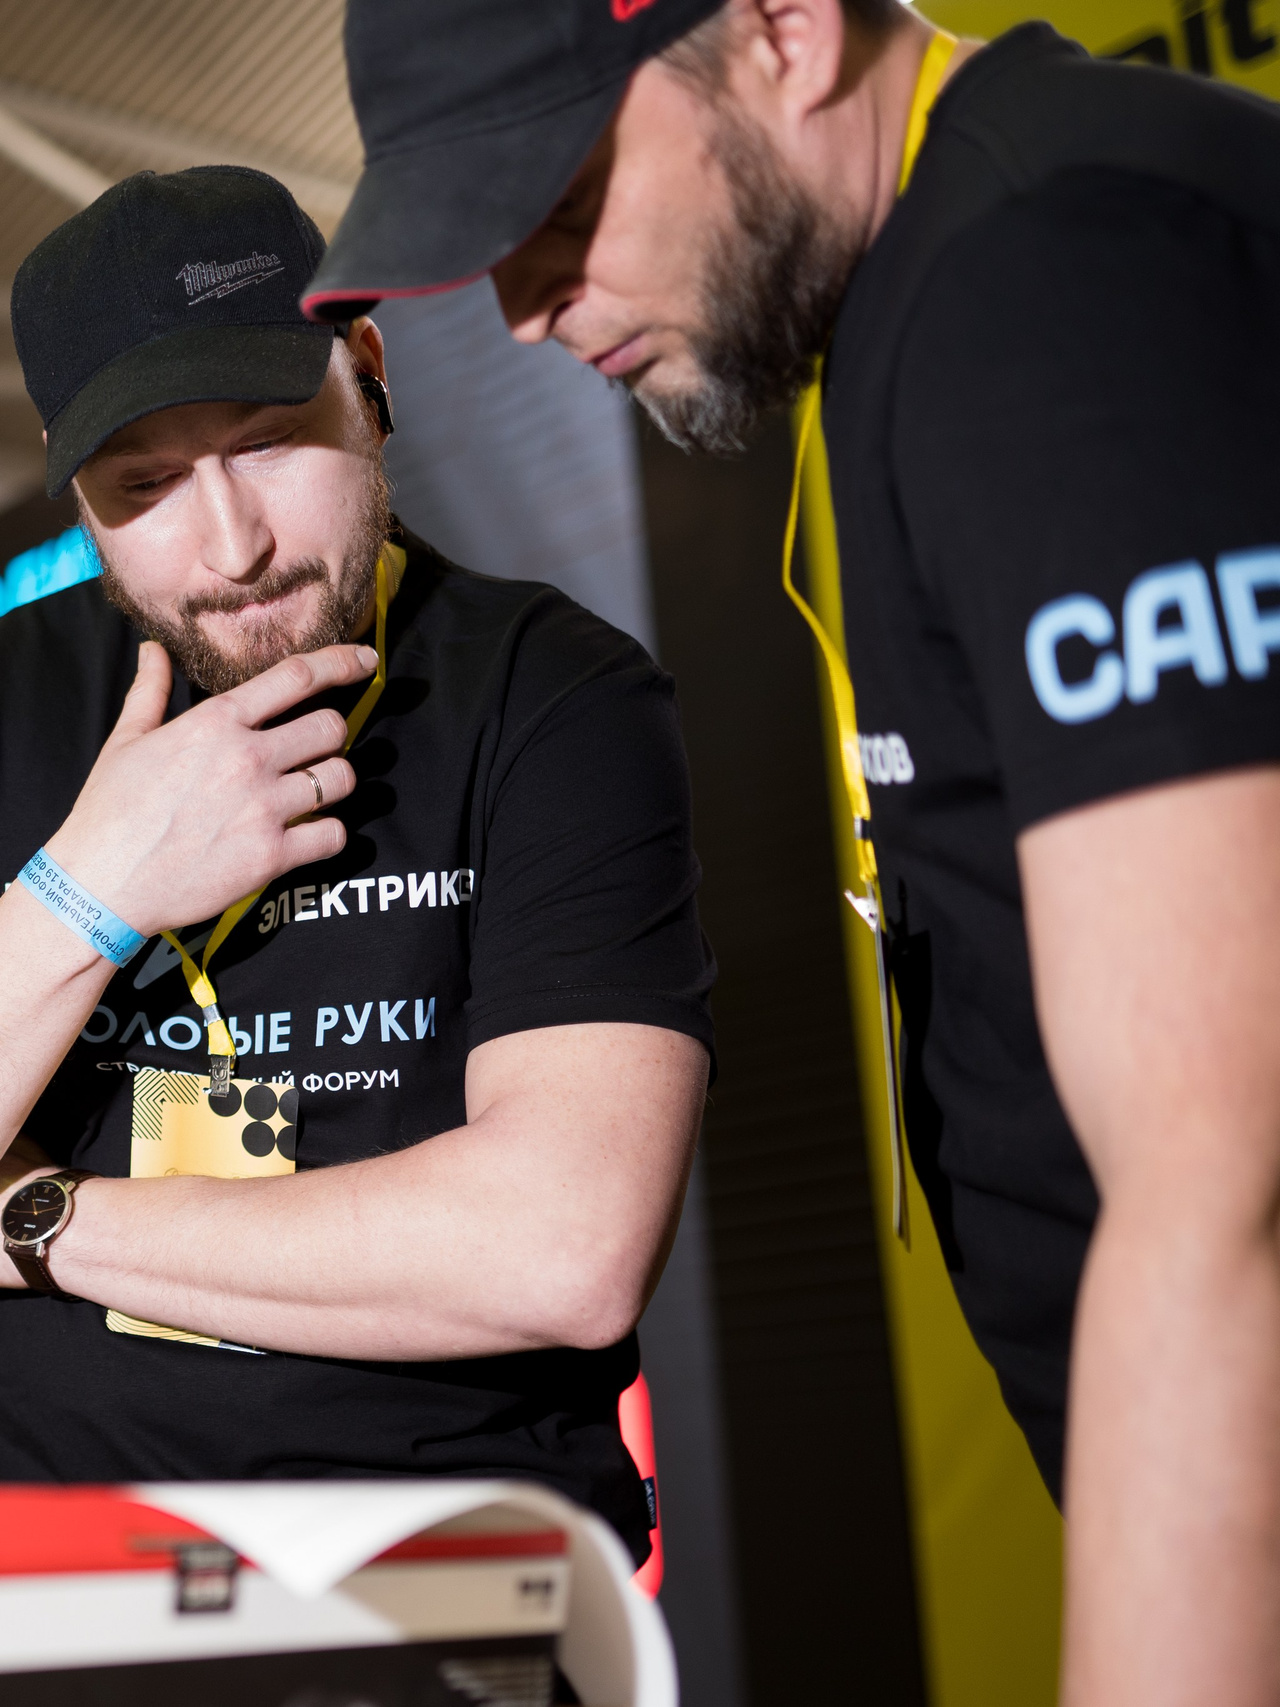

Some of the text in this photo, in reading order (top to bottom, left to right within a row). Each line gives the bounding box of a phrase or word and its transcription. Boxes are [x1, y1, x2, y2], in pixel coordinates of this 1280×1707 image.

[45, 868, 59, 882] 19
[58, 879, 102, 920] САМАРА
[45, 887, 125, 957] СТРОИТЕЛЬНЫЙ
[315, 997, 436, 1047] РУКИ
[302, 1068, 400, 1093] ФОРУМ
